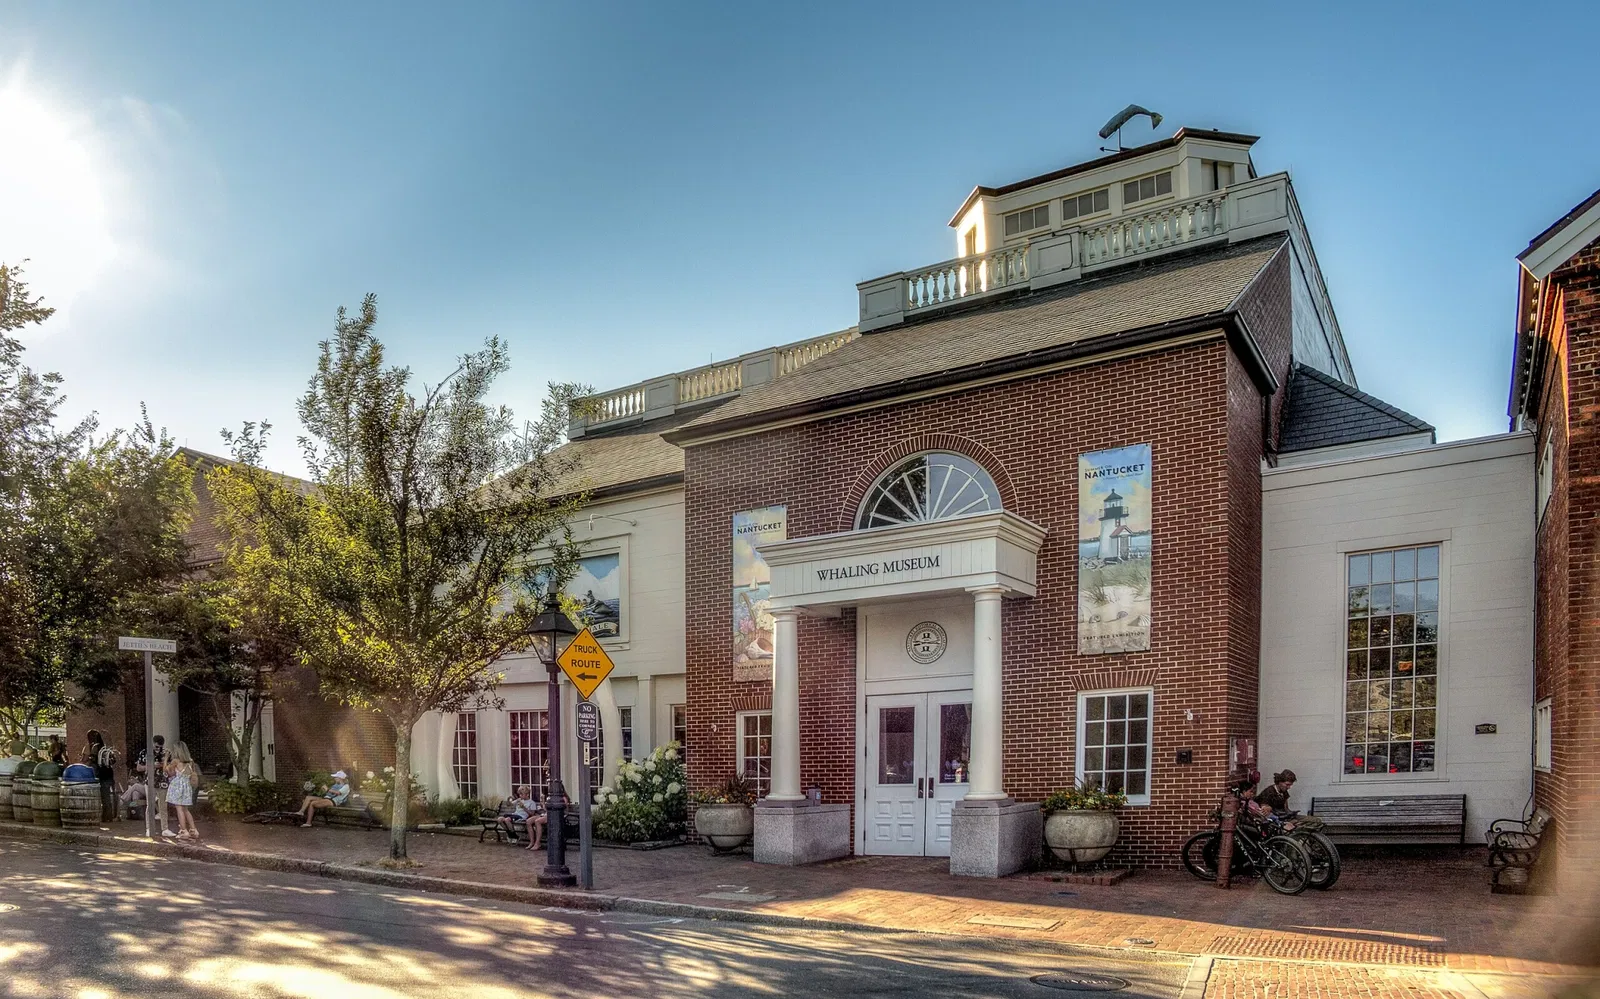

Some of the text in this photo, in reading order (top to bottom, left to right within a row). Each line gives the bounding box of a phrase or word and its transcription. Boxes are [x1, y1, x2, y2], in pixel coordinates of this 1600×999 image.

[1085, 463, 1145, 479] NANTUCKET
[737, 522, 782, 534] NANTUCKET
[817, 555, 940, 581] WHALING MUSEUM
[574, 645, 598, 654] TRUCK
[571, 659, 601, 669] ROUTE
[578, 712, 596, 720] PARKING
